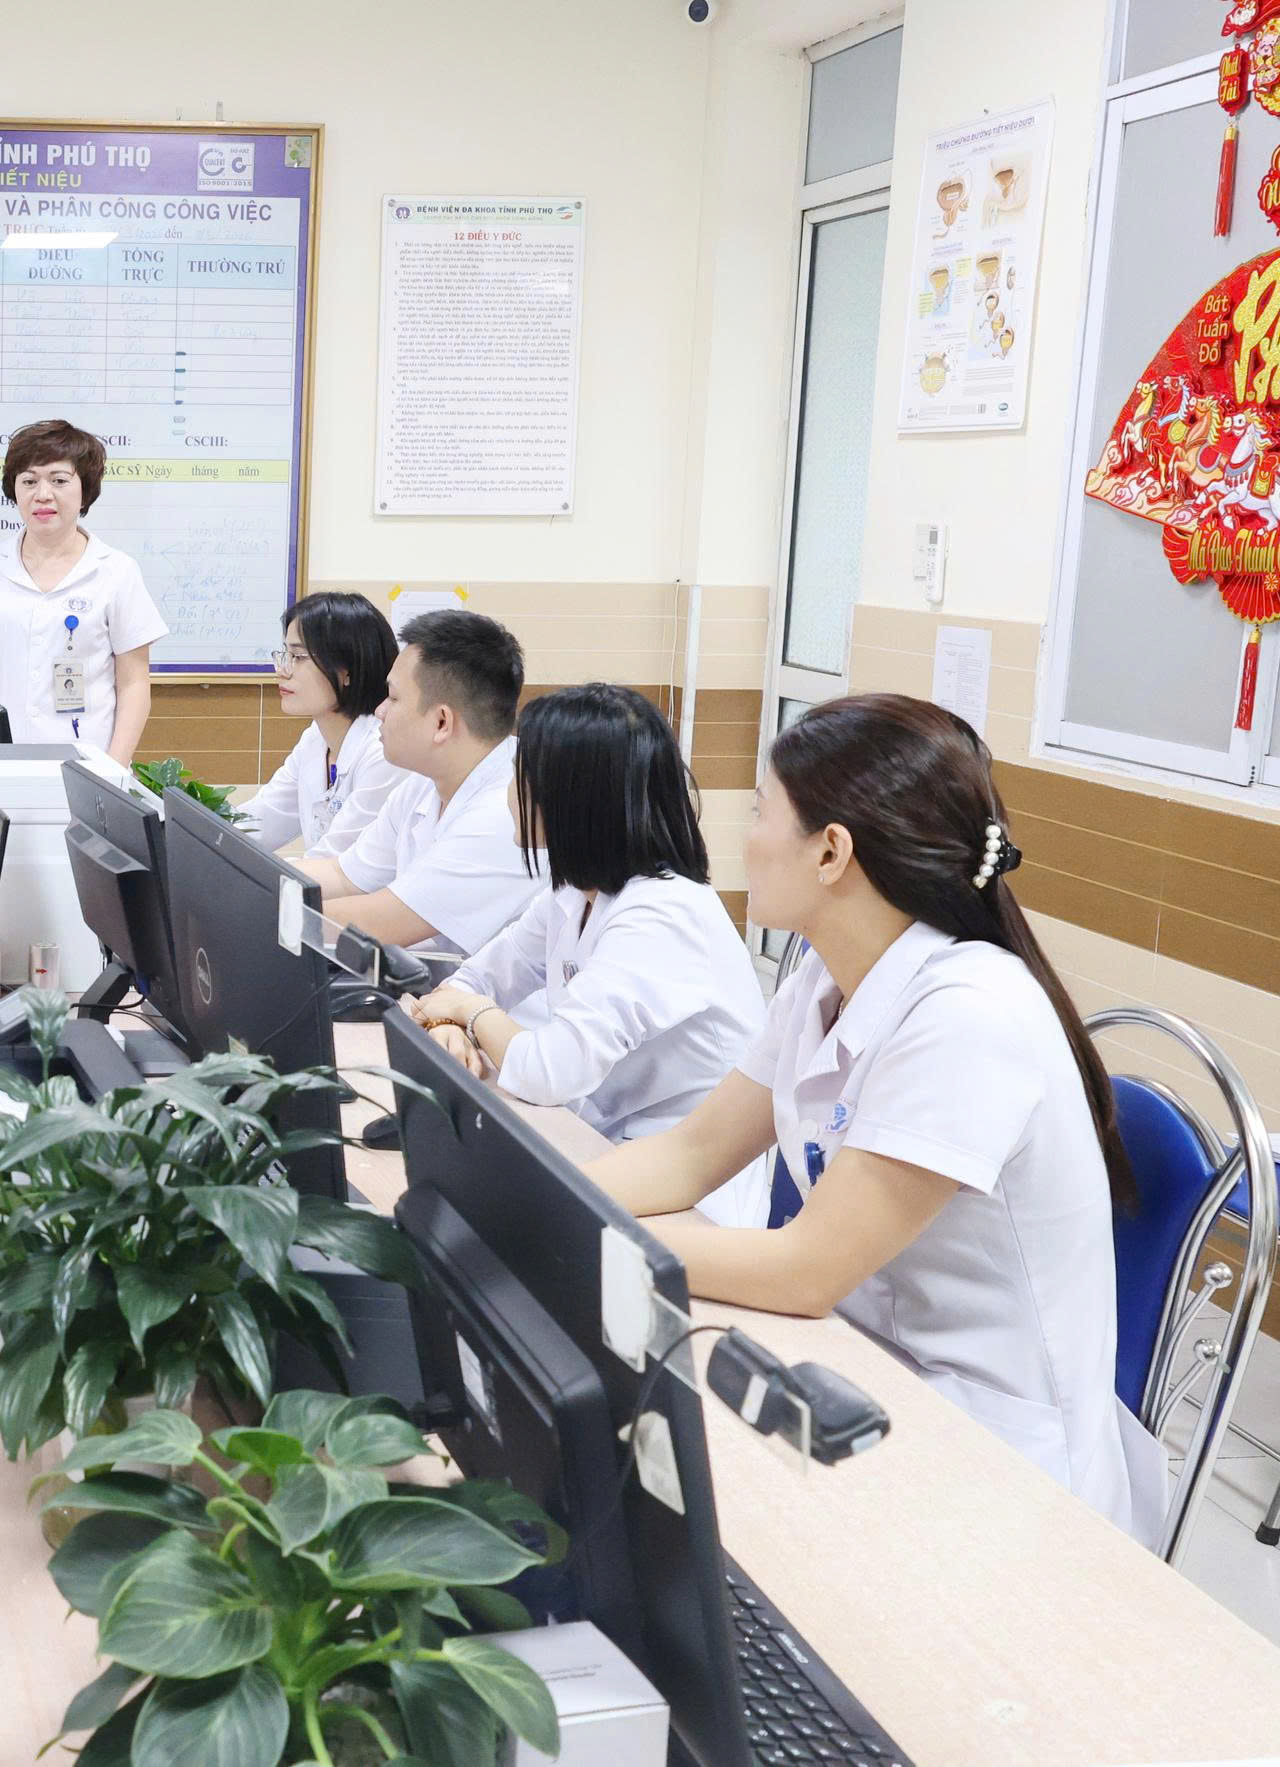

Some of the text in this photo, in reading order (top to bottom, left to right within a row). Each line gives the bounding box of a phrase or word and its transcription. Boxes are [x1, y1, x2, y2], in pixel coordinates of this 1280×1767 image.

[47, 140, 96, 166] PHÚ
[105, 145, 152, 172] THỌ
[37, 170, 82, 189] NIỆU
[5, 195, 31, 216] VÀ
[38, 195, 92, 218] PHÂN
[99, 198, 156, 219] CÔNG
[163, 199, 220, 220] CÔNG
[228, 199, 272, 224] VIỆC
[417, 205, 439, 214] BỆNH
[441, 205, 459, 214] VIỆN
[538, 206, 553, 215] THỌ
[164, 225, 183, 240] đến
[454, 229, 522, 241] 12 ĐIỀU Y ĐỨC
[28, 264, 83, 280] DƯỠNG
[188, 258, 286, 275] THƯỜNG TRÚ
[122, 268, 164, 284] TRỰC
[1204, 294, 1229, 314] Bát
[1196, 314, 1229, 338] Tuấn
[1199, 341, 1219, 363] Đồ
[145, 464, 172, 478] Ngày
[191, 464, 220, 479] tháng
[238, 466, 260, 477] năm
